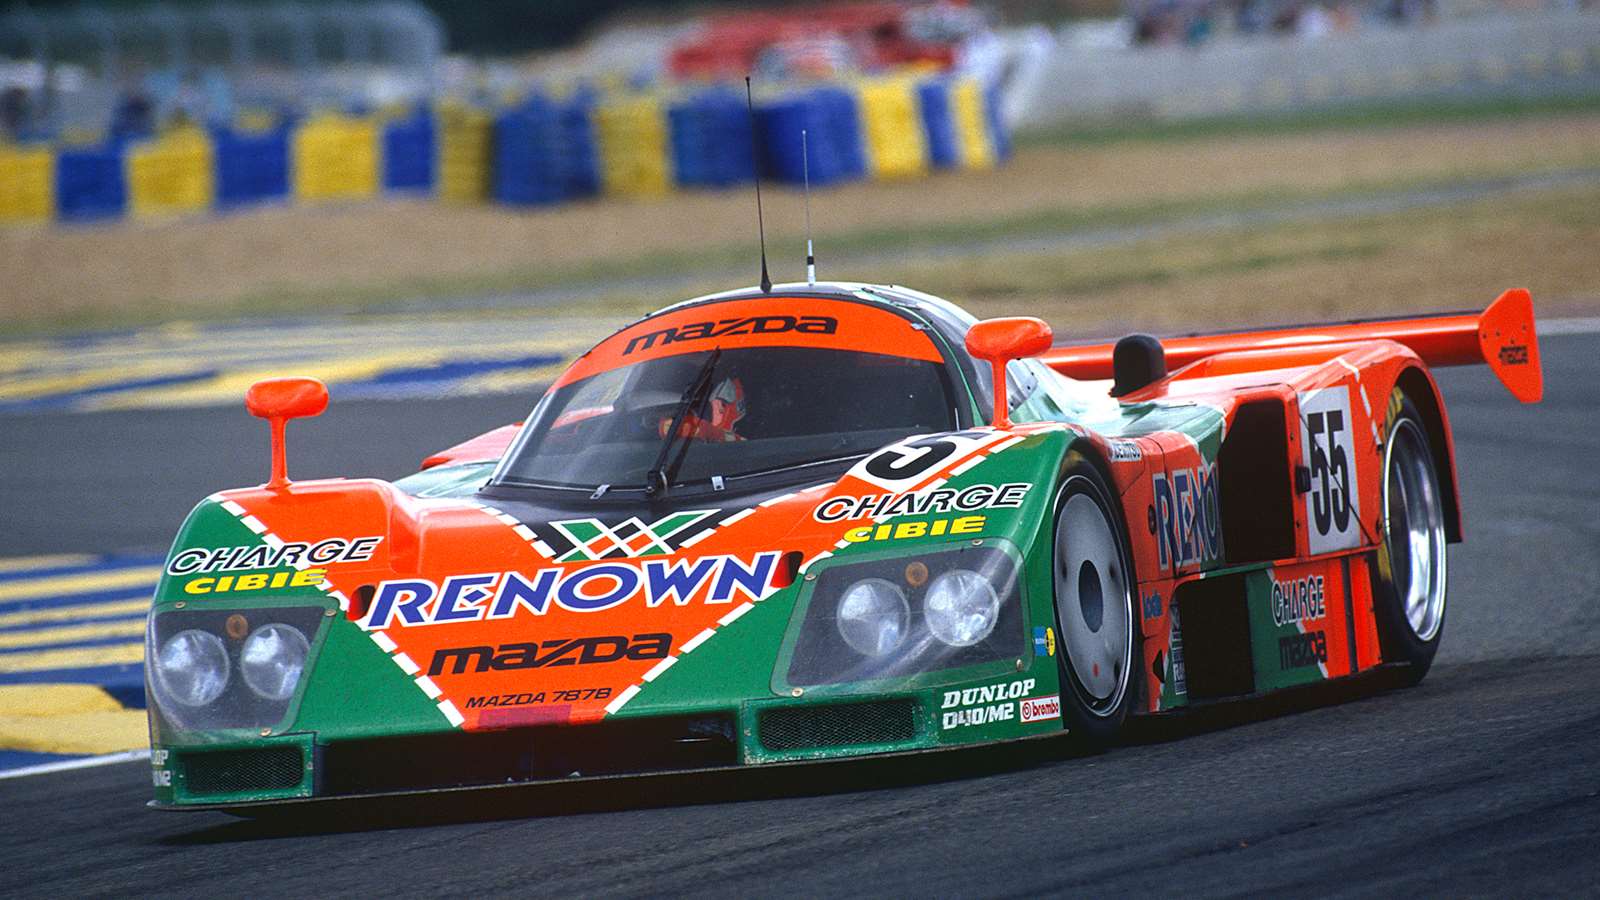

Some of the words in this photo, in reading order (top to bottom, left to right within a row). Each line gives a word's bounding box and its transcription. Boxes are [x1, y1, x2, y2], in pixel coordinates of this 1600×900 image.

[622, 315, 838, 355] mazda
[1306, 409, 1350, 536] 55
[812, 483, 1033, 524] CHARGE
[843, 515, 987, 543] CIBIE
[167, 536, 384, 576] CHARGE
[184, 568, 328, 595] CIBIE
[364, 550, 782, 631] RENOWN
[1271, 574, 1326, 628] CHARGE
[427, 632, 674, 677] mazda
[465, 691, 546, 710] MAZDA
[552, 686, 613, 702] 787B
[941, 678, 1036, 709] DUNLOP
[942, 702, 1015, 730] D40/M2
